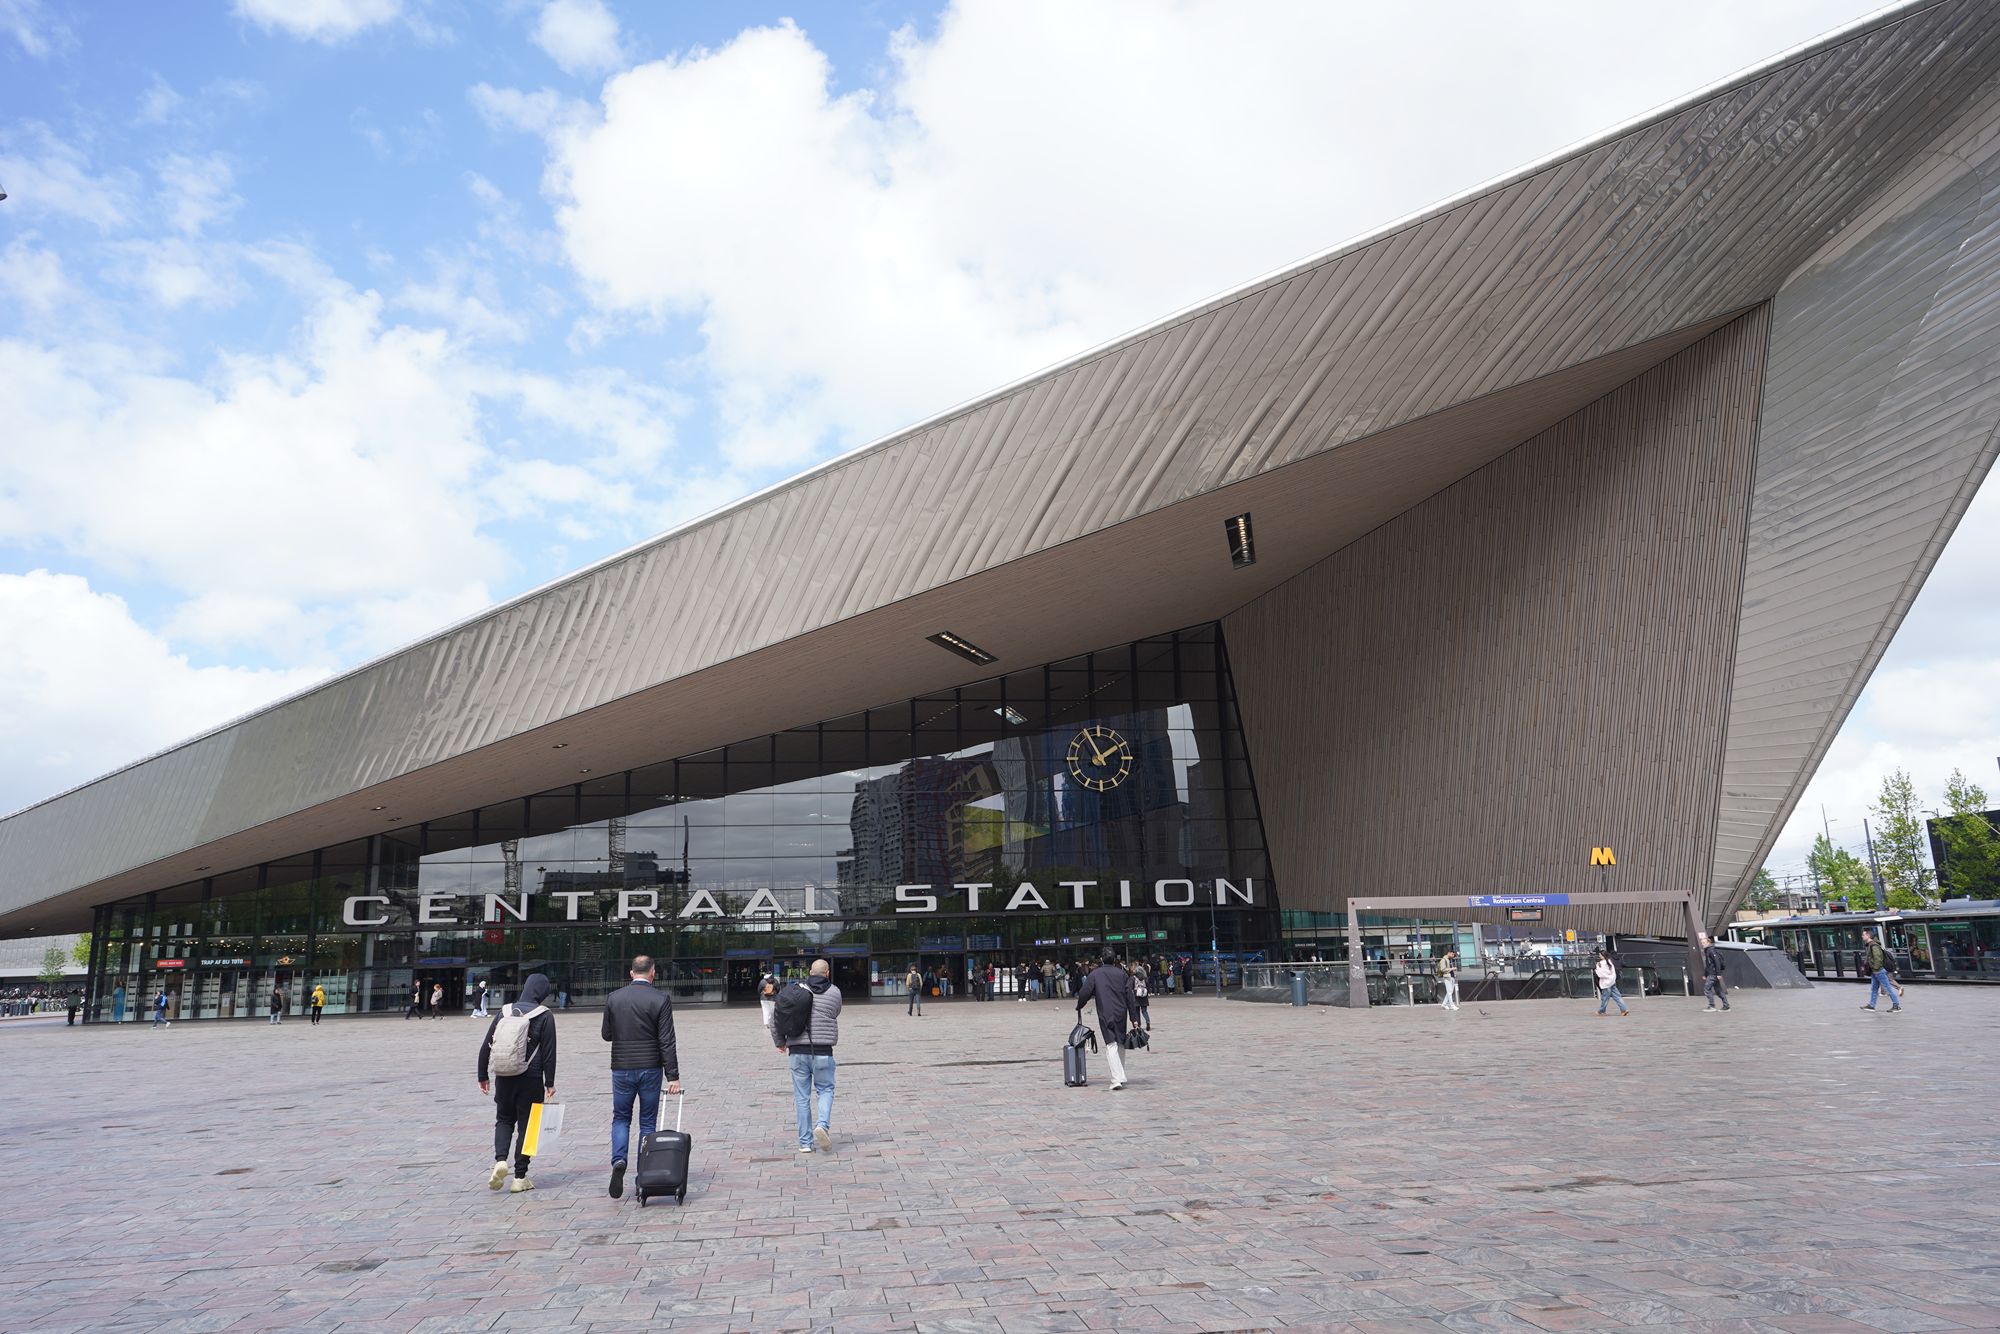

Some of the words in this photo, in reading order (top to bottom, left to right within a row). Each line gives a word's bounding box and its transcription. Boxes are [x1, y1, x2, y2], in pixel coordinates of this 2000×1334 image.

[1591, 847, 1616, 865] M
[343, 884, 836, 926] CENTRAAL
[895, 877, 1254, 913] STATION
[1523, 896, 1545, 904] Centraal
